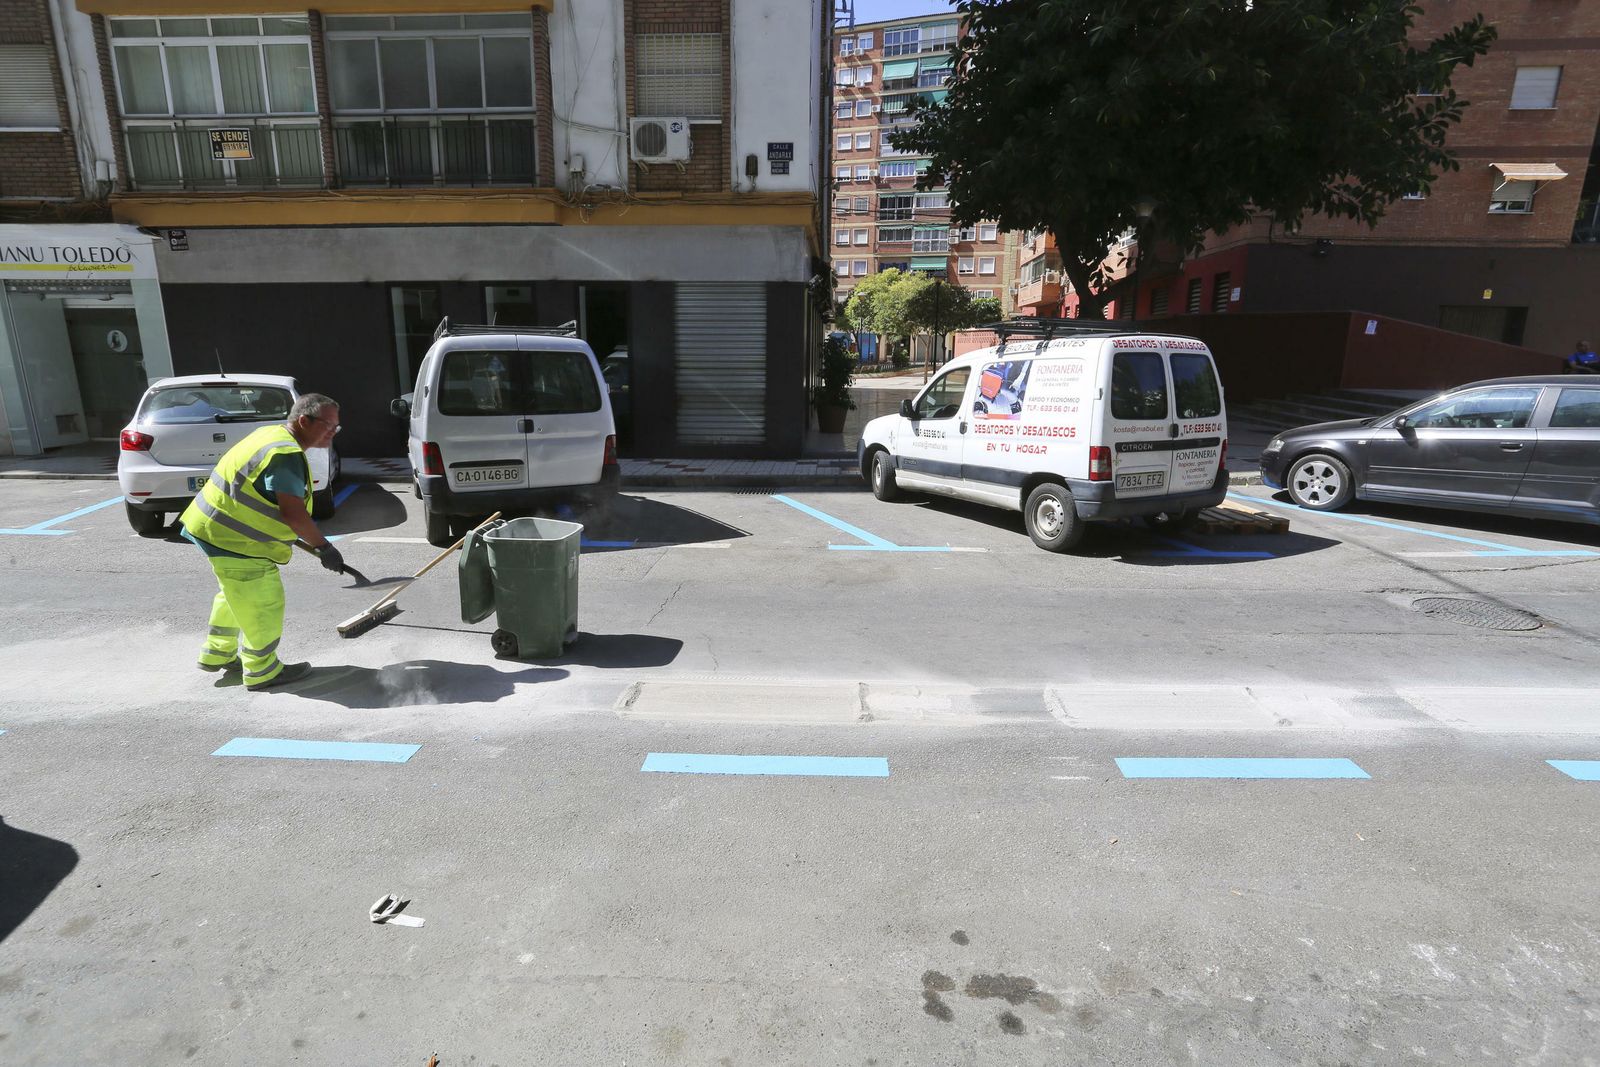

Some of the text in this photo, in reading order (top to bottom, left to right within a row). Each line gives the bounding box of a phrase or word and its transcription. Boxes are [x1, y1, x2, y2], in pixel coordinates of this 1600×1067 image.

[212, 131, 248, 141] SE VENDE
[0, 246, 131, 263] ANU TOLEDO
[1021, 343, 1035, 351] DE
[1113, 339, 1158, 348] DESATOROS
[1164, 340, 1207, 350] DESATASCOS
[1040, 404, 1052, 412] 633
[1063, 405, 1071, 413] 01
[974, 424, 1076, 438] DESATOROS Y DESATASCOS
[1194, 424, 1205, 433] 633
[1205, 424, 1211, 432] 56
[986, 442, 1048, 455] EN TU HOGAR
[1121, 474, 1162, 487] 7834 FFZ
